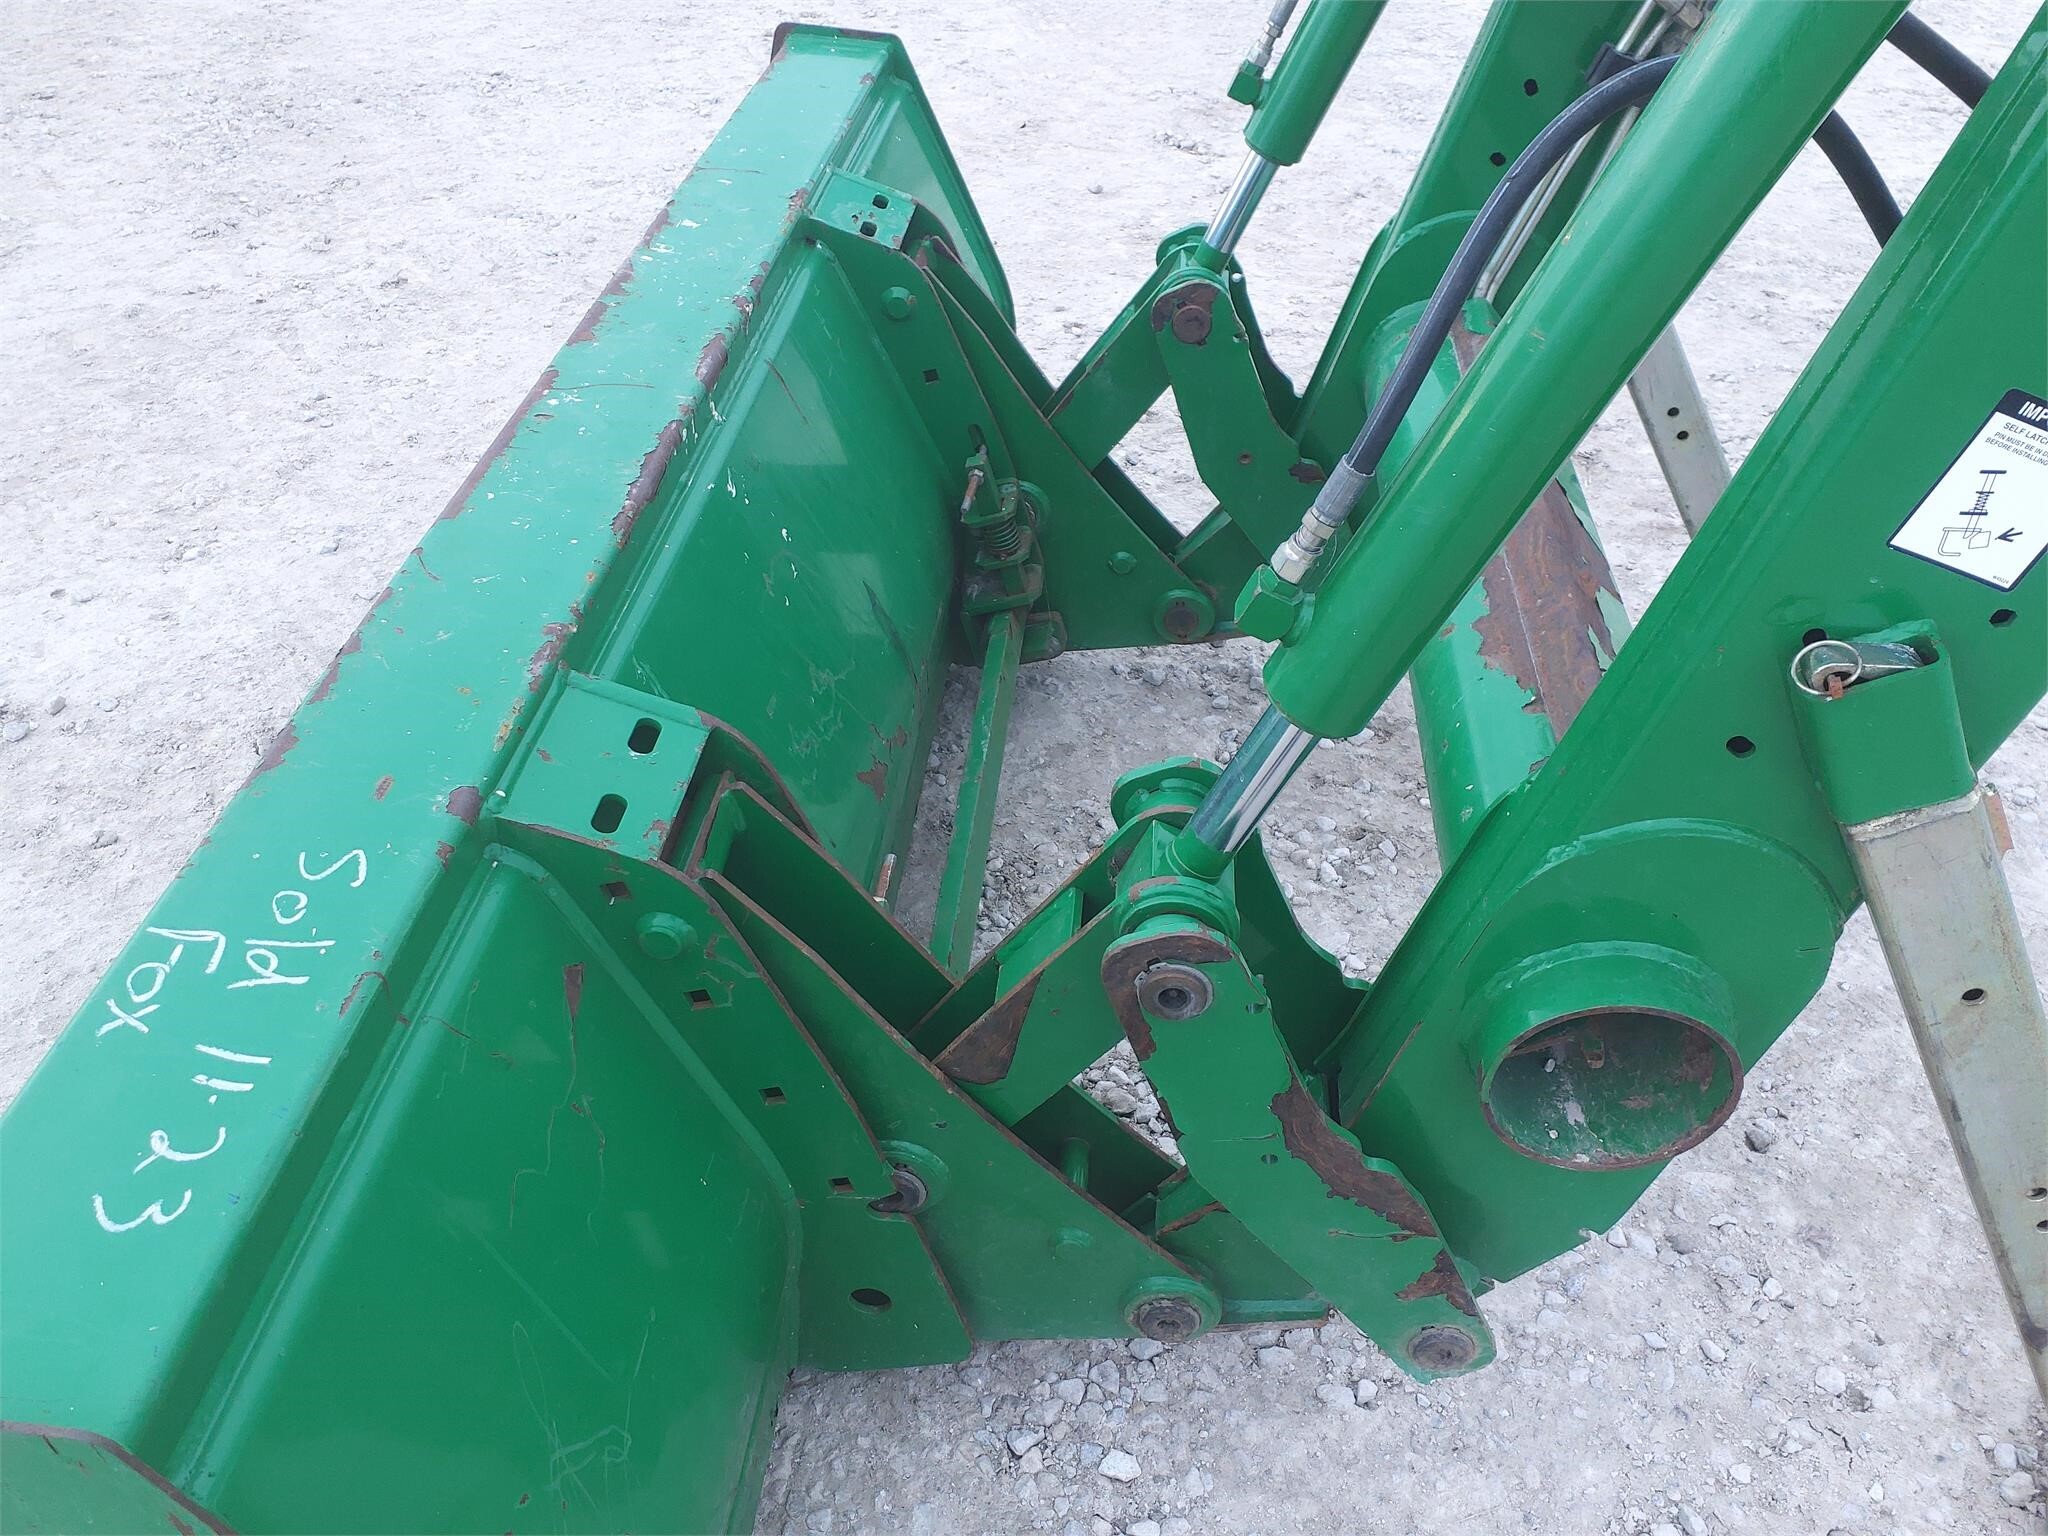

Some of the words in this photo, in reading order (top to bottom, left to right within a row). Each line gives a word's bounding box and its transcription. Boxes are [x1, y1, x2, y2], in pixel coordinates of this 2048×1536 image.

[2018, 400, 2048, 424] IMP
[2003, 422, 2026, 435] SELF
[1985, 437, 2012, 452] BEFORE
[2011, 447, 2048, 466] INSTALLING
[1994, 431, 2006, 441] PIN
[2006, 436, 2025, 448] MUST
[2024, 443, 2035, 452] BE
[2034, 447, 2043, 455] IN
[227, 848, 367, 990] Sold
[96, 926, 226, 1037] Fox
